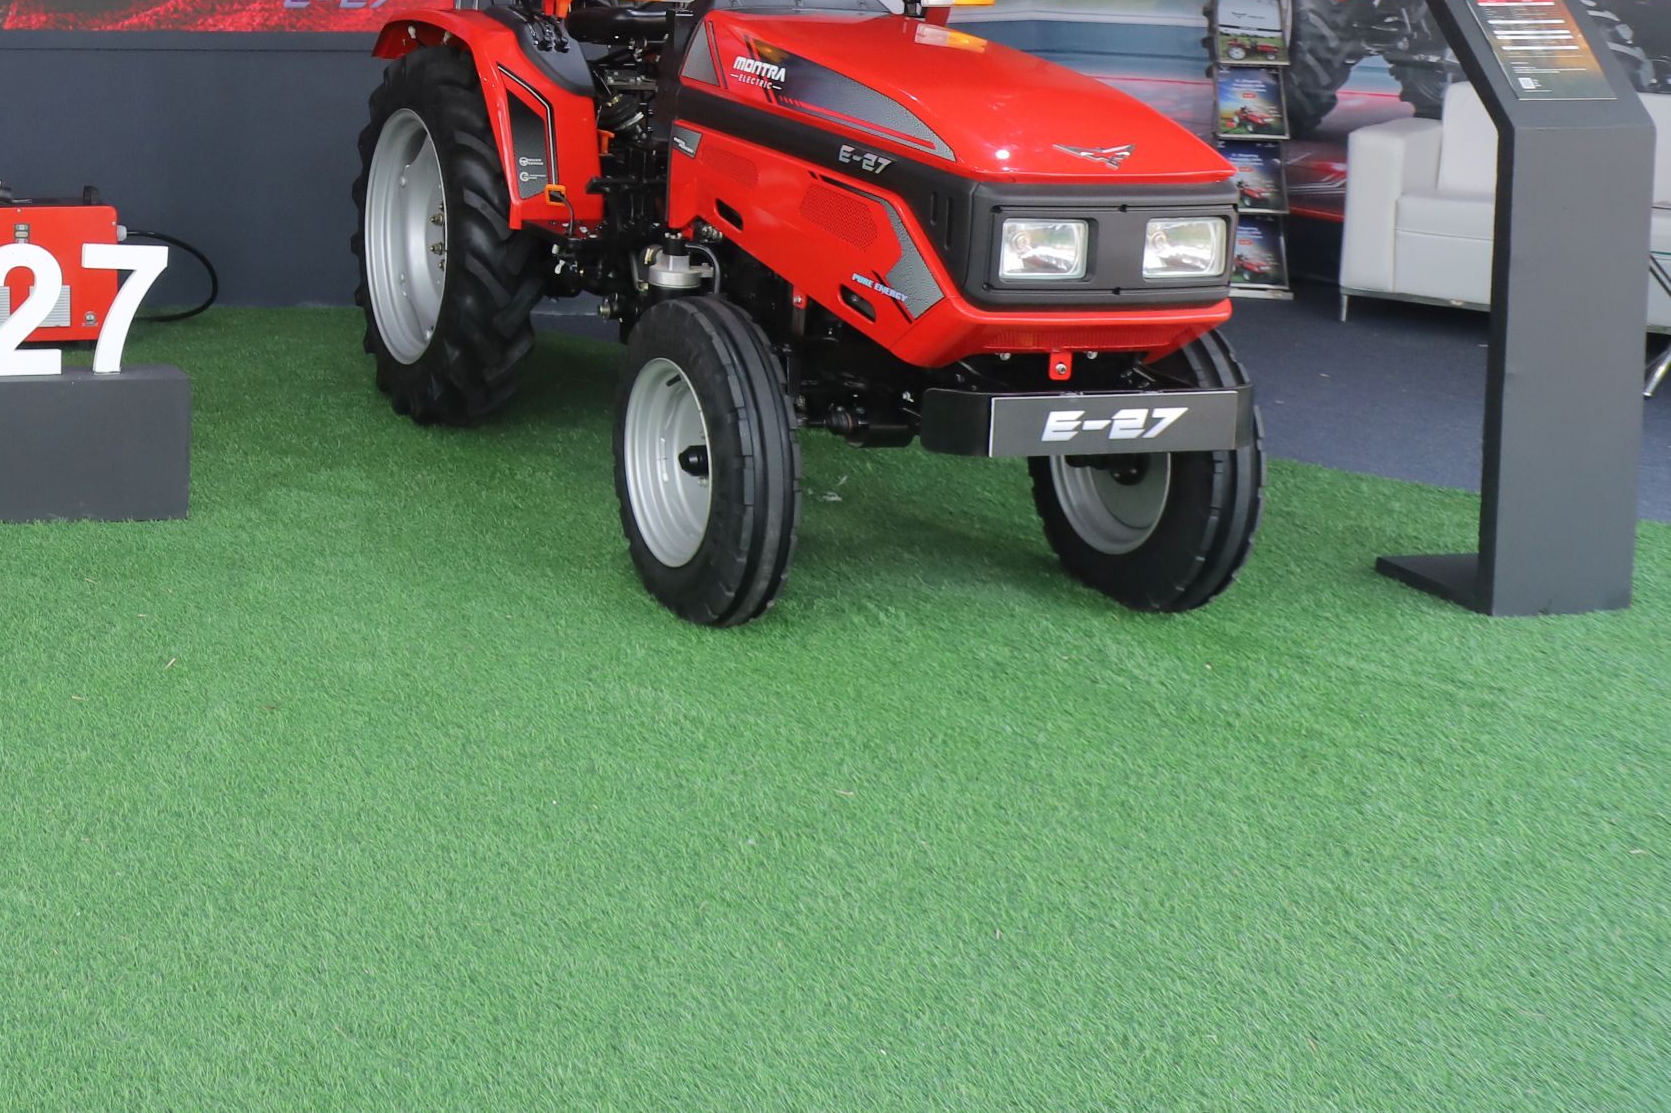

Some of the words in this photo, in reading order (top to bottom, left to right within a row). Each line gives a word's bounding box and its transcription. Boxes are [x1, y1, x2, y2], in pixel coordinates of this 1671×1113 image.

[733, 56, 787, 83] MONTRA
[738, 74, 773, 90] ELECTRIC
[837, 143, 893, 175] E-27
[874, 282, 908, 302] ENERGY
[1041, 407, 1189, 442] E-27
